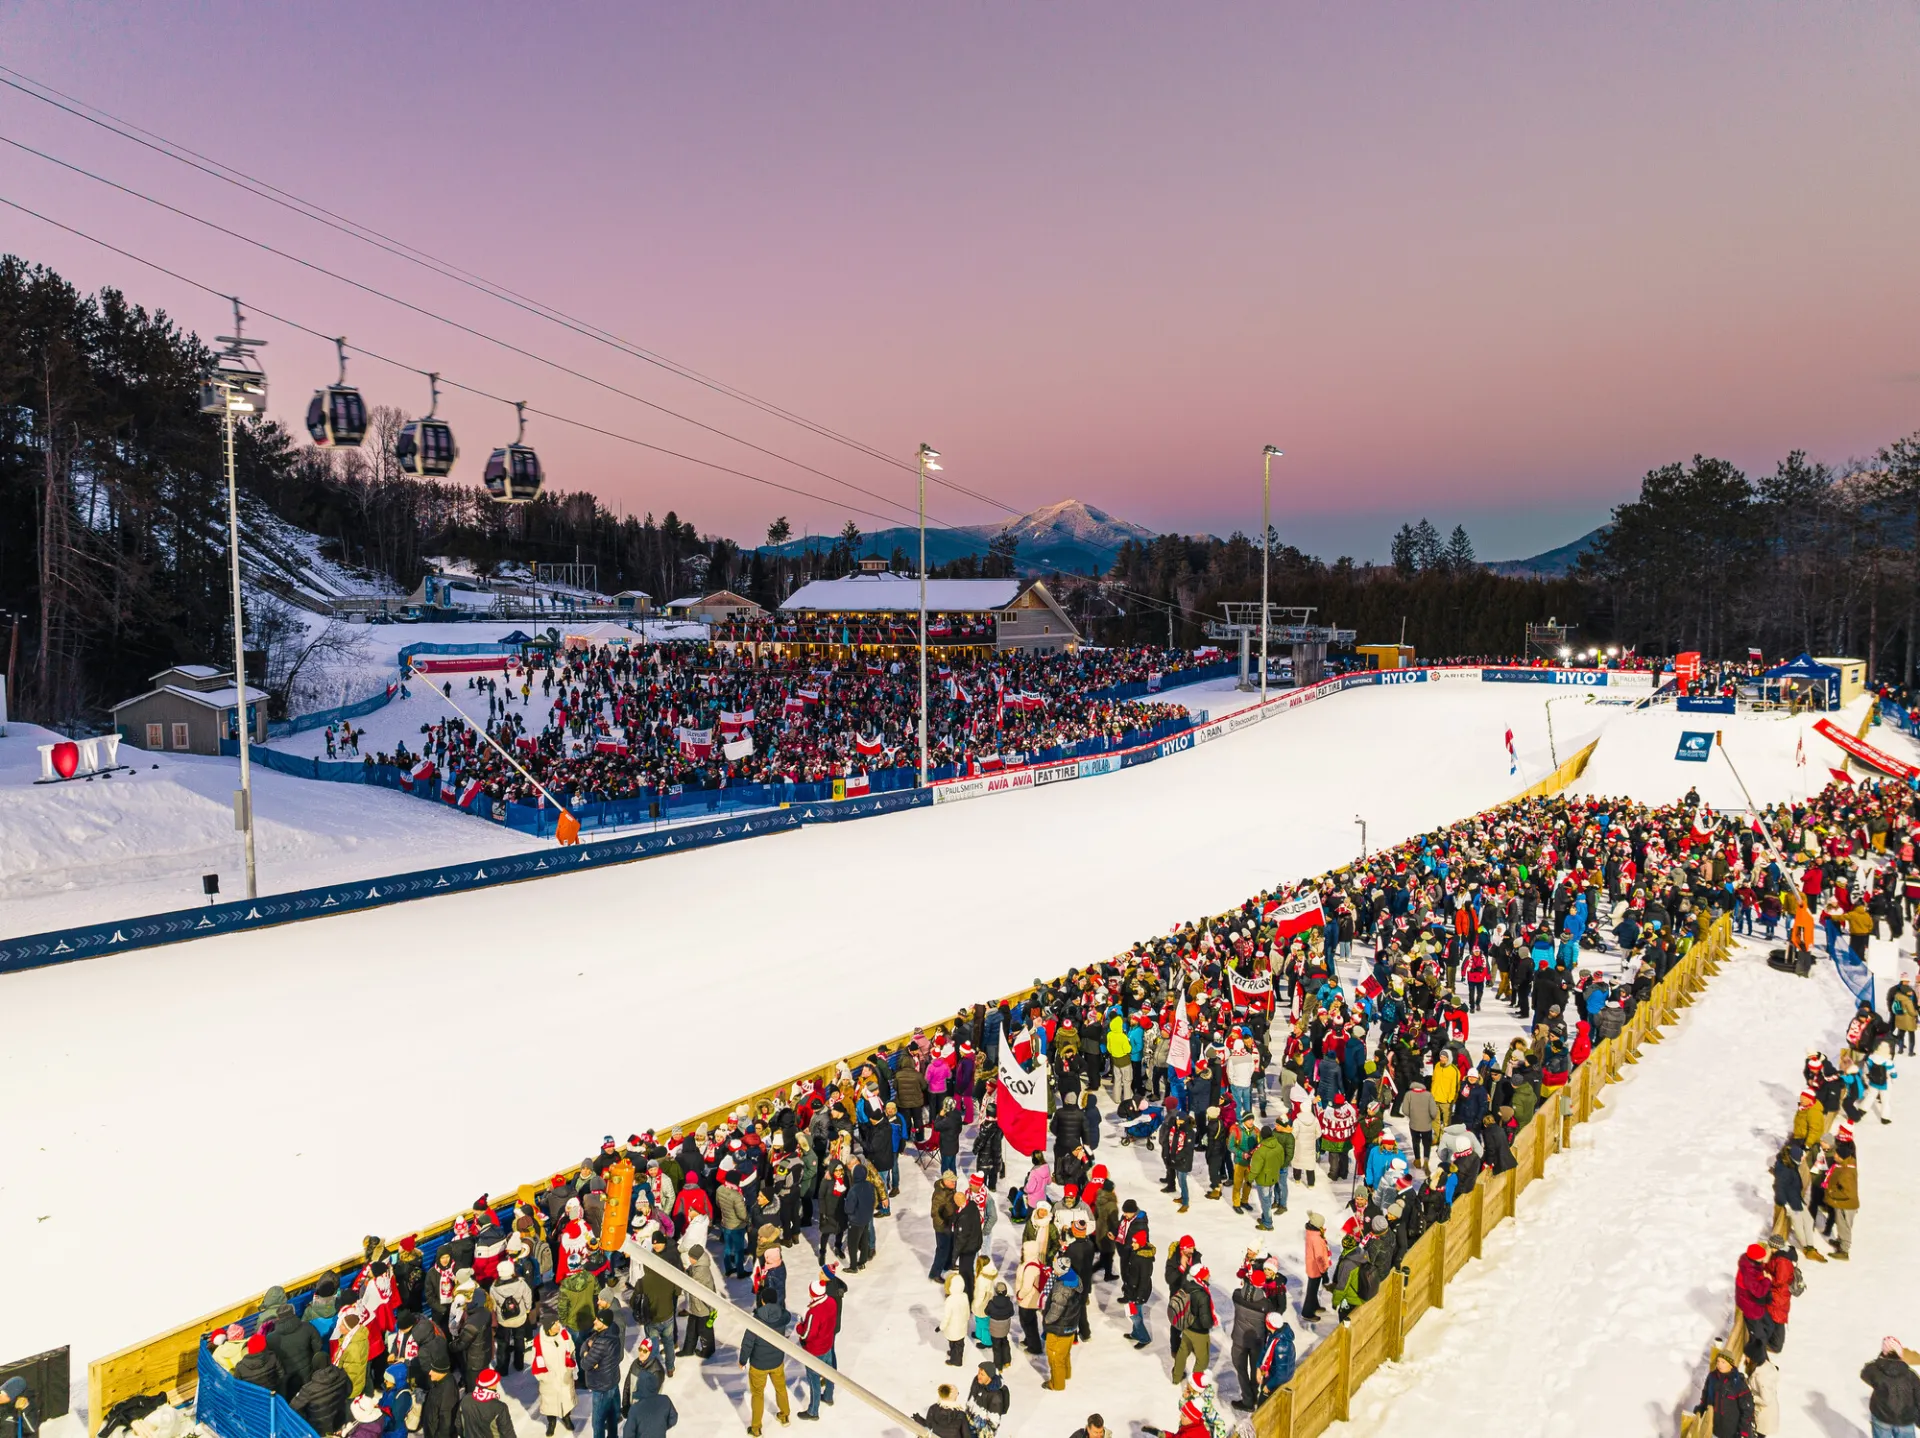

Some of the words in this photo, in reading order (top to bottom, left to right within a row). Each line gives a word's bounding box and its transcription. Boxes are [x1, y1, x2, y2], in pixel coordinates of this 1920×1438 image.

[1382, 671, 1417, 684] HYLO
[1556, 671, 1597, 685] HYLO
[1318, 686, 1327, 697] FAT
[1328, 682, 1341, 694] TIRE
[1206, 725, 1223, 738] RAIN
[76, 733, 123, 773] NY
[1162, 738, 1188, 757] HYLO
[1037, 769, 1054, 783] FAT
[1055, 766, 1075, 779] TIRE
[945, 786, 961, 795] PAUL
